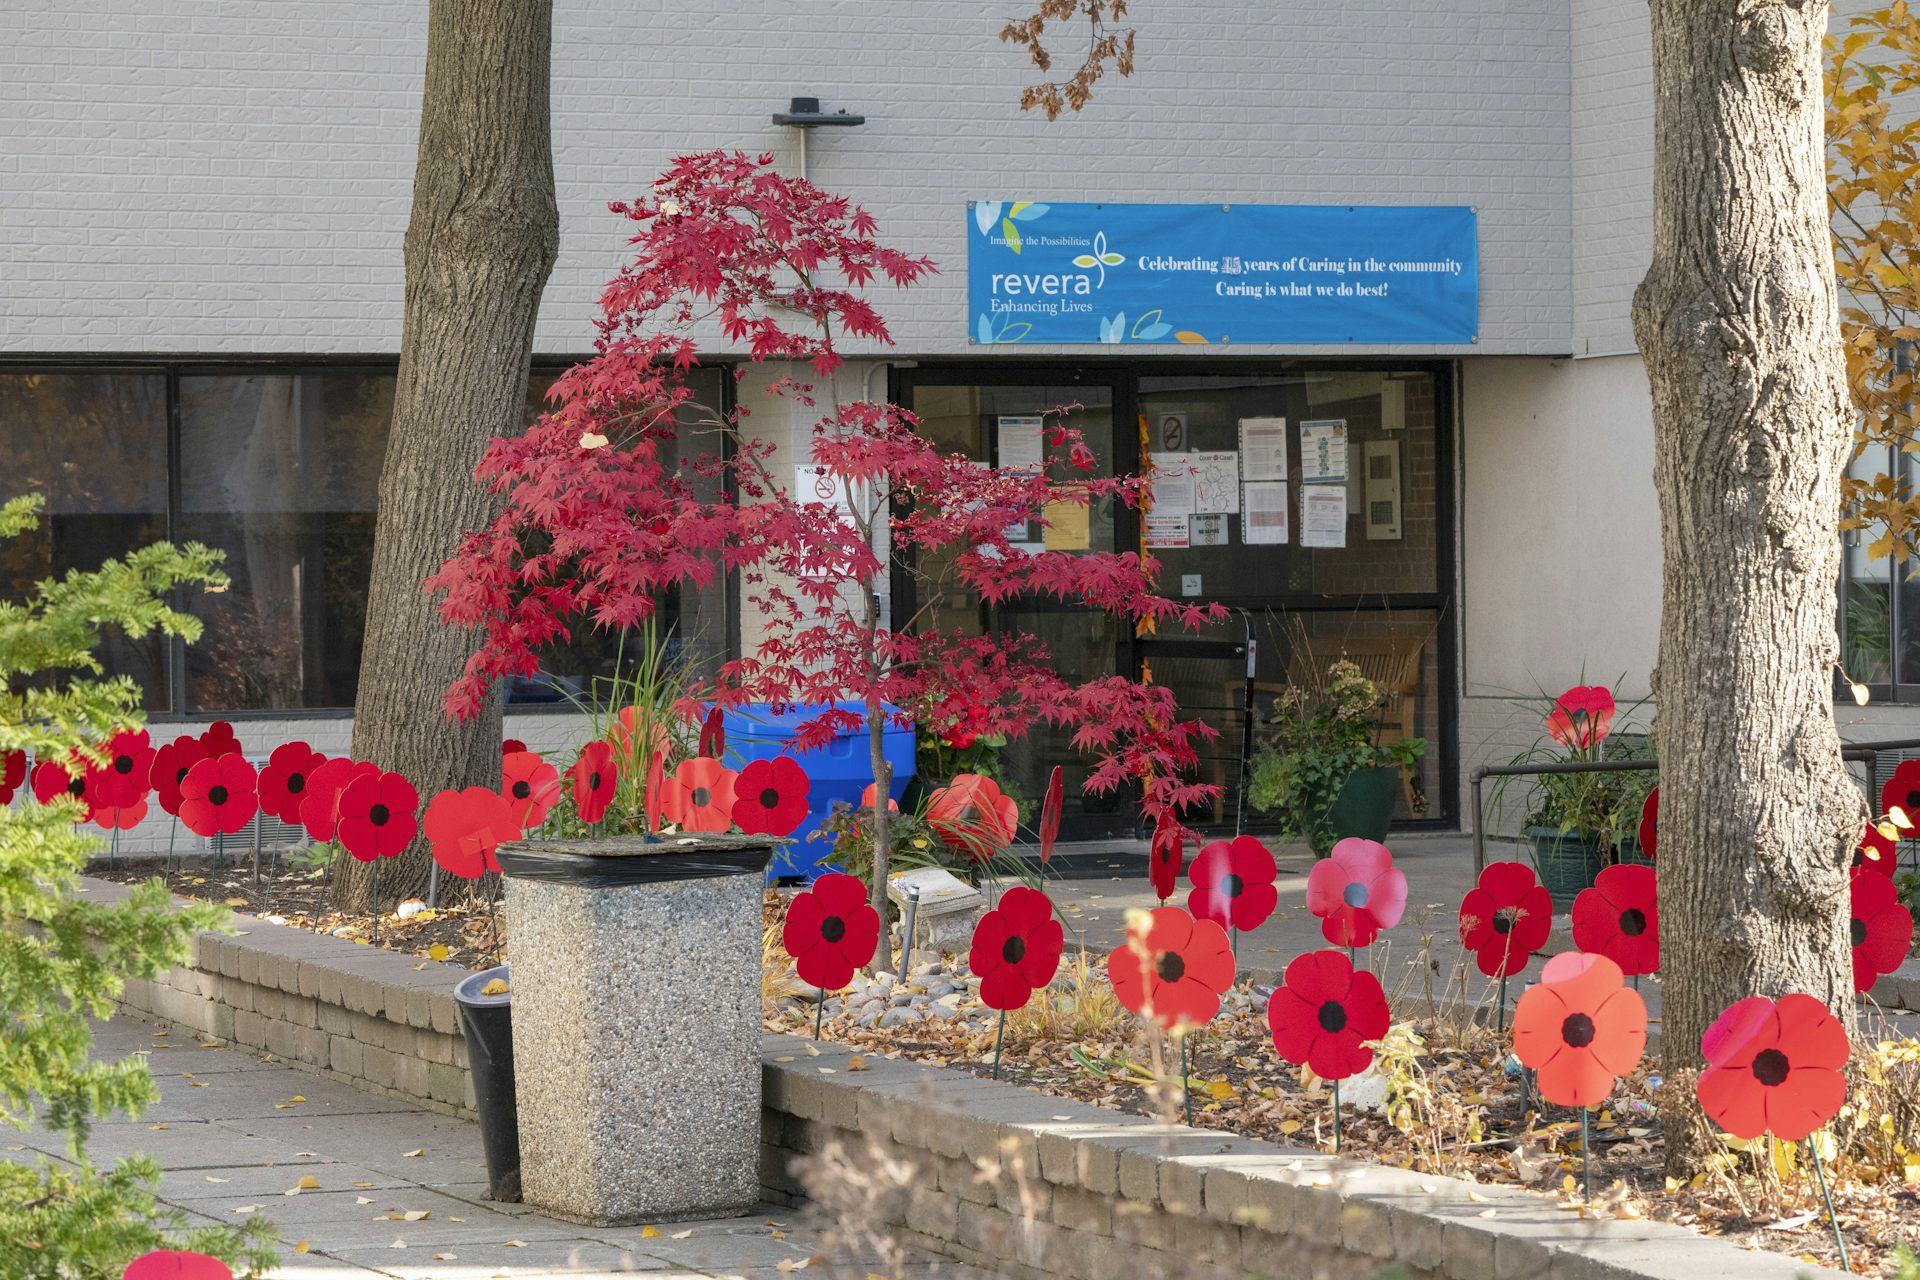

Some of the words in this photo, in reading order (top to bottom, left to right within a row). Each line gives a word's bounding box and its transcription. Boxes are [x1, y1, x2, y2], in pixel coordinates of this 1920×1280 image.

[990, 236, 1024, 247] Imagine
[1026, 236, 1039, 245] the
[1041, 236, 1091, 246] Possibilities
[1138, 256, 1218, 274] Celebrating
[1243, 260, 1280, 275] years
[1282, 256, 1298, 271] of
[1299, 256, 1345, 275] Caring
[1348, 257, 1361, 272] in
[1364, 257, 1387, 272] the
[1389, 258, 1463, 276] community
[991, 274, 1091, 295] revera
[1215, 281, 1262, 299] Caring
[1265, 282, 1277, 296] is
[1279, 282, 1312, 296] what
[1316, 285, 1334, 296] we
[1336, 282, 1353, 296] do
[1356, 282, 1388, 296] best!
[990, 299, 1058, 316] Enhancing
[1061, 299, 1093, 312] Lives
